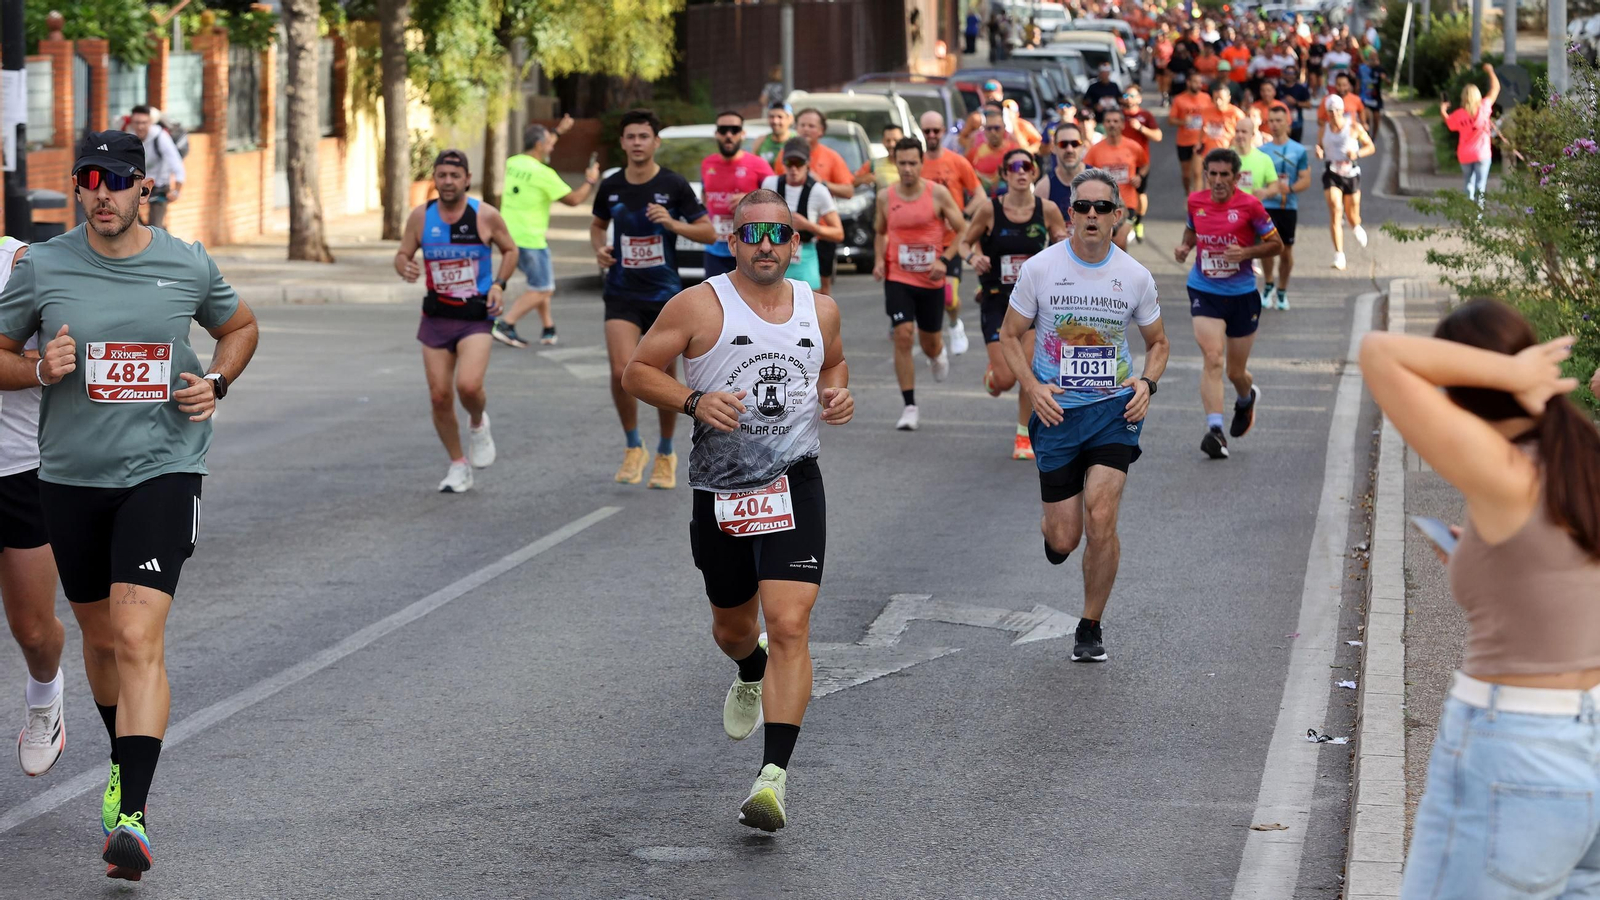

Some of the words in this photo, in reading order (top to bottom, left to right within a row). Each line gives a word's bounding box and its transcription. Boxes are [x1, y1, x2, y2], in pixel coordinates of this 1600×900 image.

[631, 248, 653, 257] 506
[441, 270, 462, 280] 507
[1050, 295, 1060, 305] IV
[1061, 294, 1088, 306] MEDIA
[1091, 295, 1128, 310] MARATÓN
[1089, 317, 1123, 326] MARISMAS
[106, 363, 150, 382] 482
[725, 366, 742, 387] XXIV
[741, 352, 786, 369] CARRERA
[1071, 360, 1107, 375] 1031
[740, 423, 770, 435] PILAR
[733, 497, 773, 518] 404
